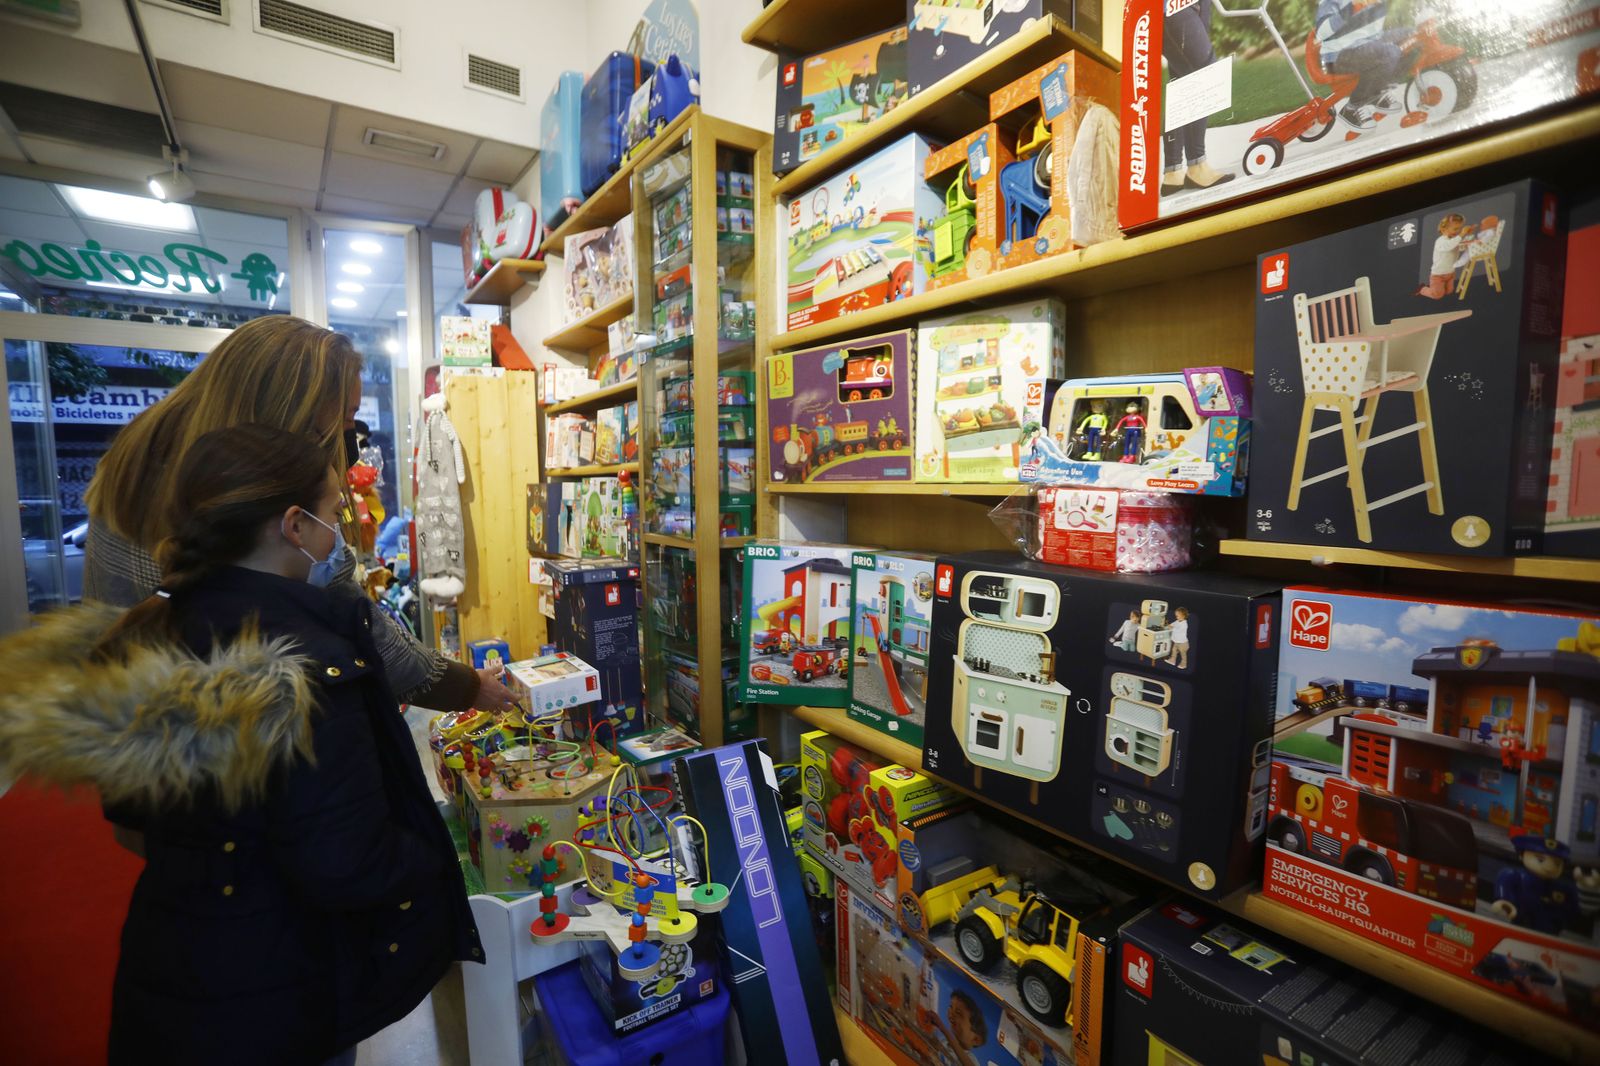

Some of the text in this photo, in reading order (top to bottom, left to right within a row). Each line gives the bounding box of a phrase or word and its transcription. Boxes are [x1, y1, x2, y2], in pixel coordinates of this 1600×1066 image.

[1130, 13, 1150, 195] RADIO FLYER
[56, 405, 123, 420] Bicicletas
[1164, 481, 1178, 489] Play
[1256, 509, 1273, 519] 3-6
[748, 546, 776, 558] BRIO
[853, 554, 873, 567] BRIO
[1293, 629, 1327, 645] Hape
[746, 687, 780, 696] Fire Station
[850, 703, 867, 718] Parking
[866, 708, 882, 722] Garage
[720, 756, 782, 929] LONDON
[1271, 857, 1369, 902] EMERGENCY
[1270, 869, 1371, 917] SERVICES HQ
[1270, 884, 1417, 949] NOTFALL-HAUPTQUARTIER
[622, 995, 680, 1025] KICK OFF TRAINER
[622, 1018, 647, 1032] FOOTBALL
[669, 1003, 679, 1012] SET
